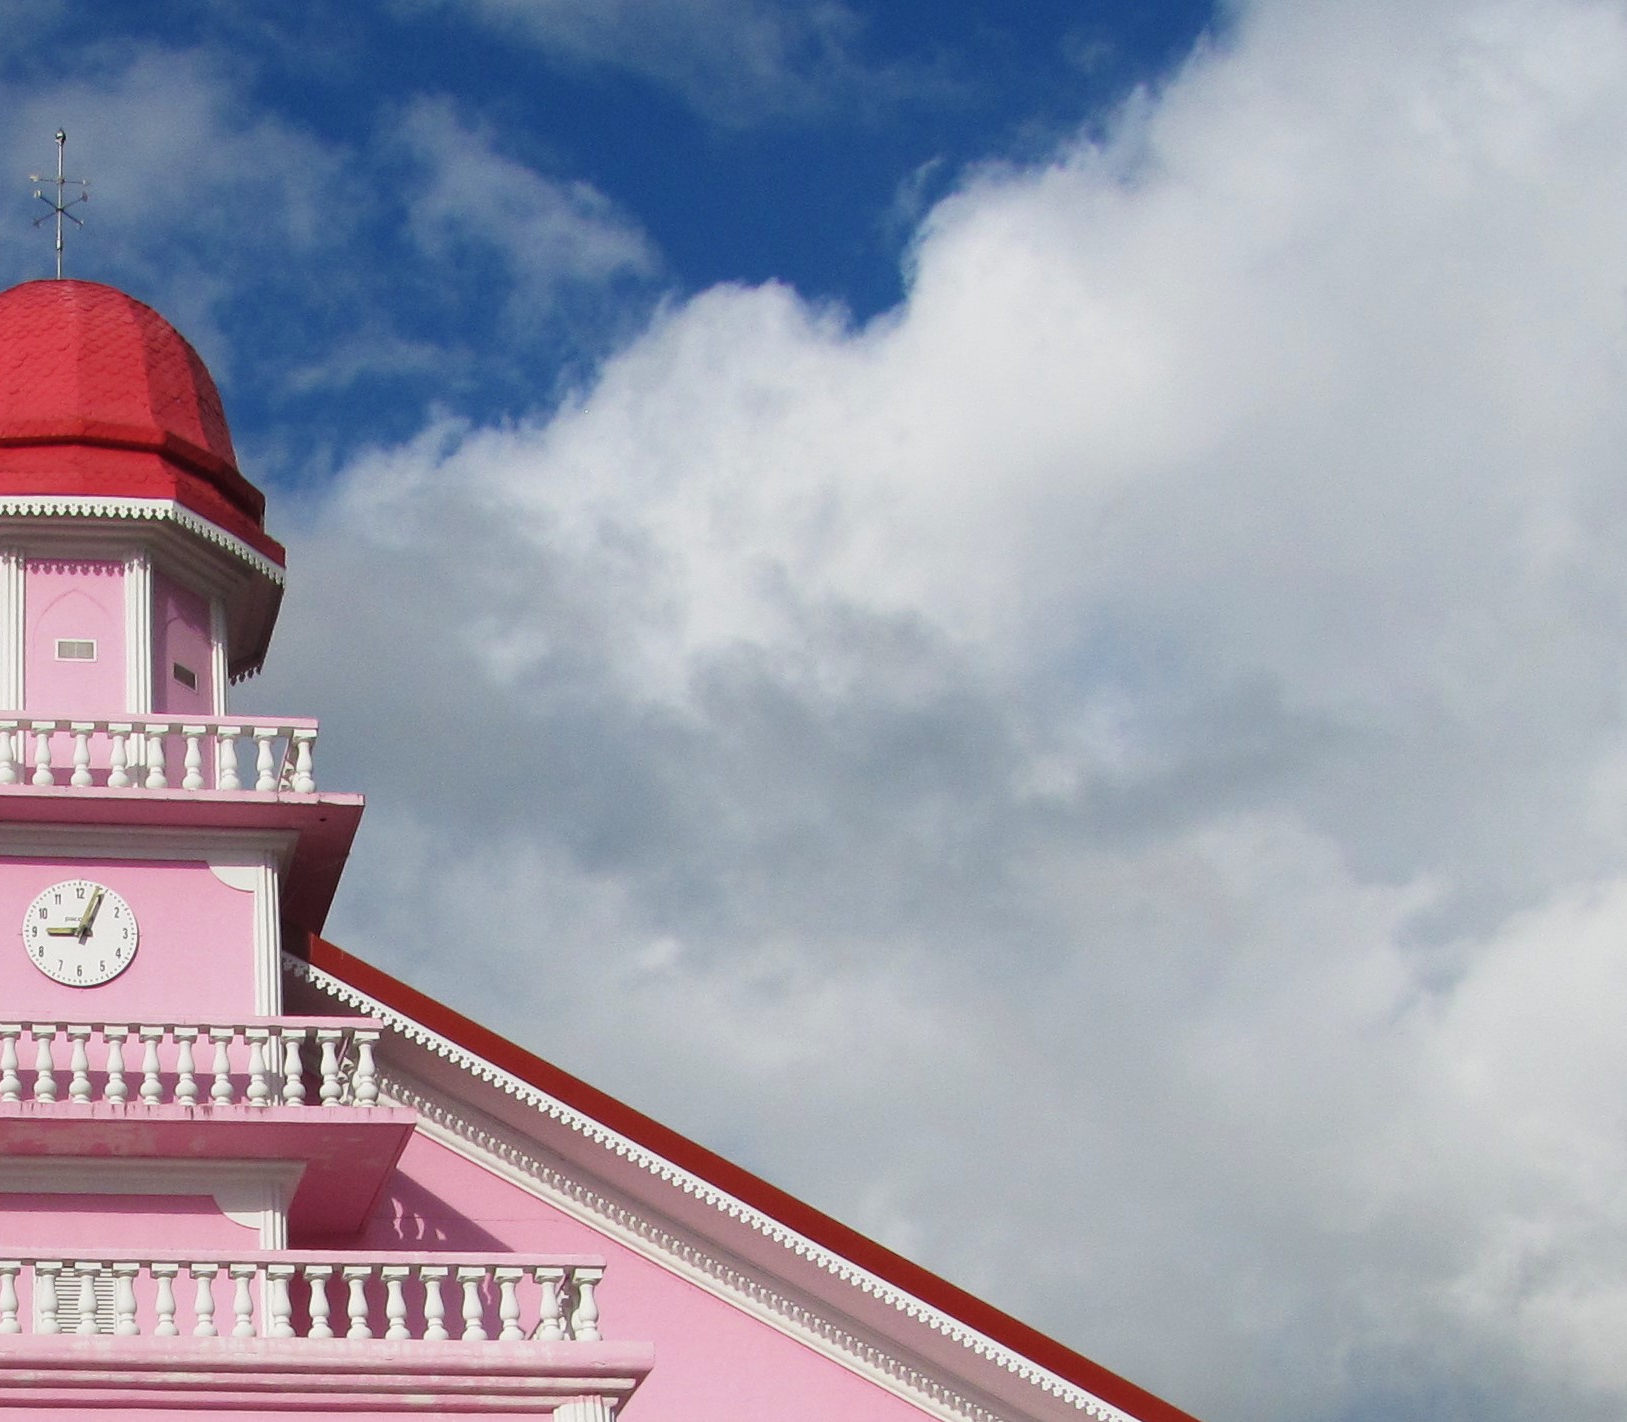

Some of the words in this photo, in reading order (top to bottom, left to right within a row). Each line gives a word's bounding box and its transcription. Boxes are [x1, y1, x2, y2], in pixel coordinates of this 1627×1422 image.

[76, 887, 85, 899] 12
[54, 894, 62, 905] 11
[39, 908, 48, 919] 10
[114, 907, 120, 918] 2
[32, 926, 38, 937] 9
[122, 928, 128, 939] 3
[38, 946, 44, 957] 8
[115, 948, 121, 959] 4
[58, 960, 64, 971] 7
[77, 965, 82, 977] 6
[100, 960, 105, 972] 5
